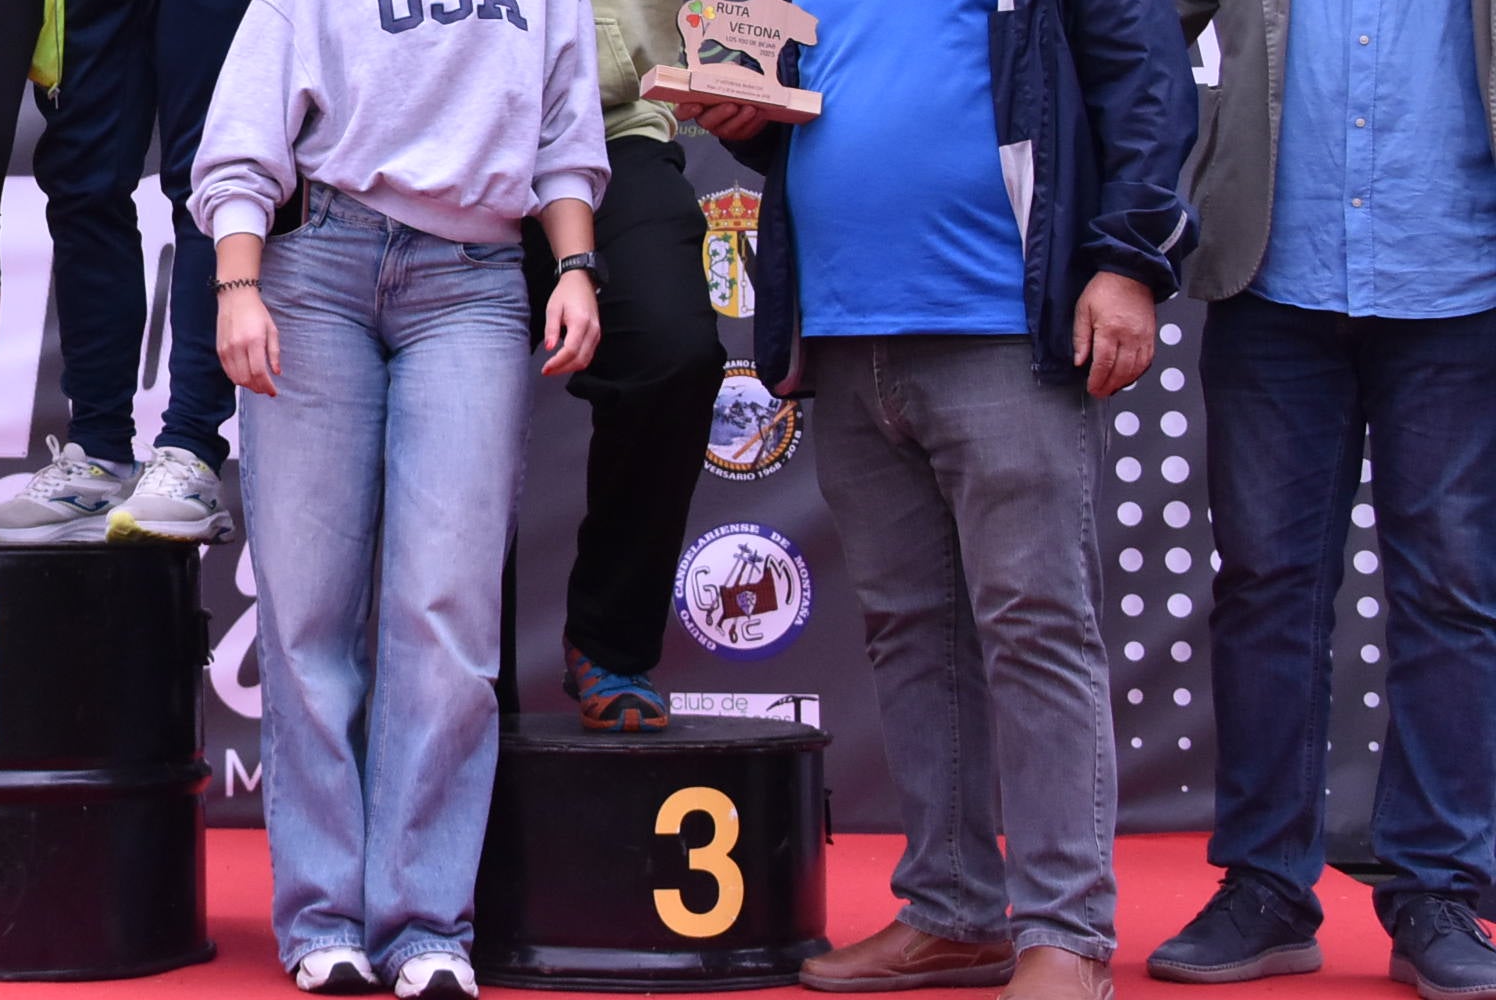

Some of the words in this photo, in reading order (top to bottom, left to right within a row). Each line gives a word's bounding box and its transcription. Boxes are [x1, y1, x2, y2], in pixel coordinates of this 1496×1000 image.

[716, 2, 750, 18] RUTA
[729, 21, 781, 41] VETONA
[769, 531, 791, 550] DE
[674, 523, 760, 599] CANDELARIENSE
[792, 554, 812, 627] MONTAÑA
[680, 608, 717, 651] GRUPO
[670, 693, 715, 711] club
[720, 693, 749, 711] de
[653, 786, 745, 938] 3
